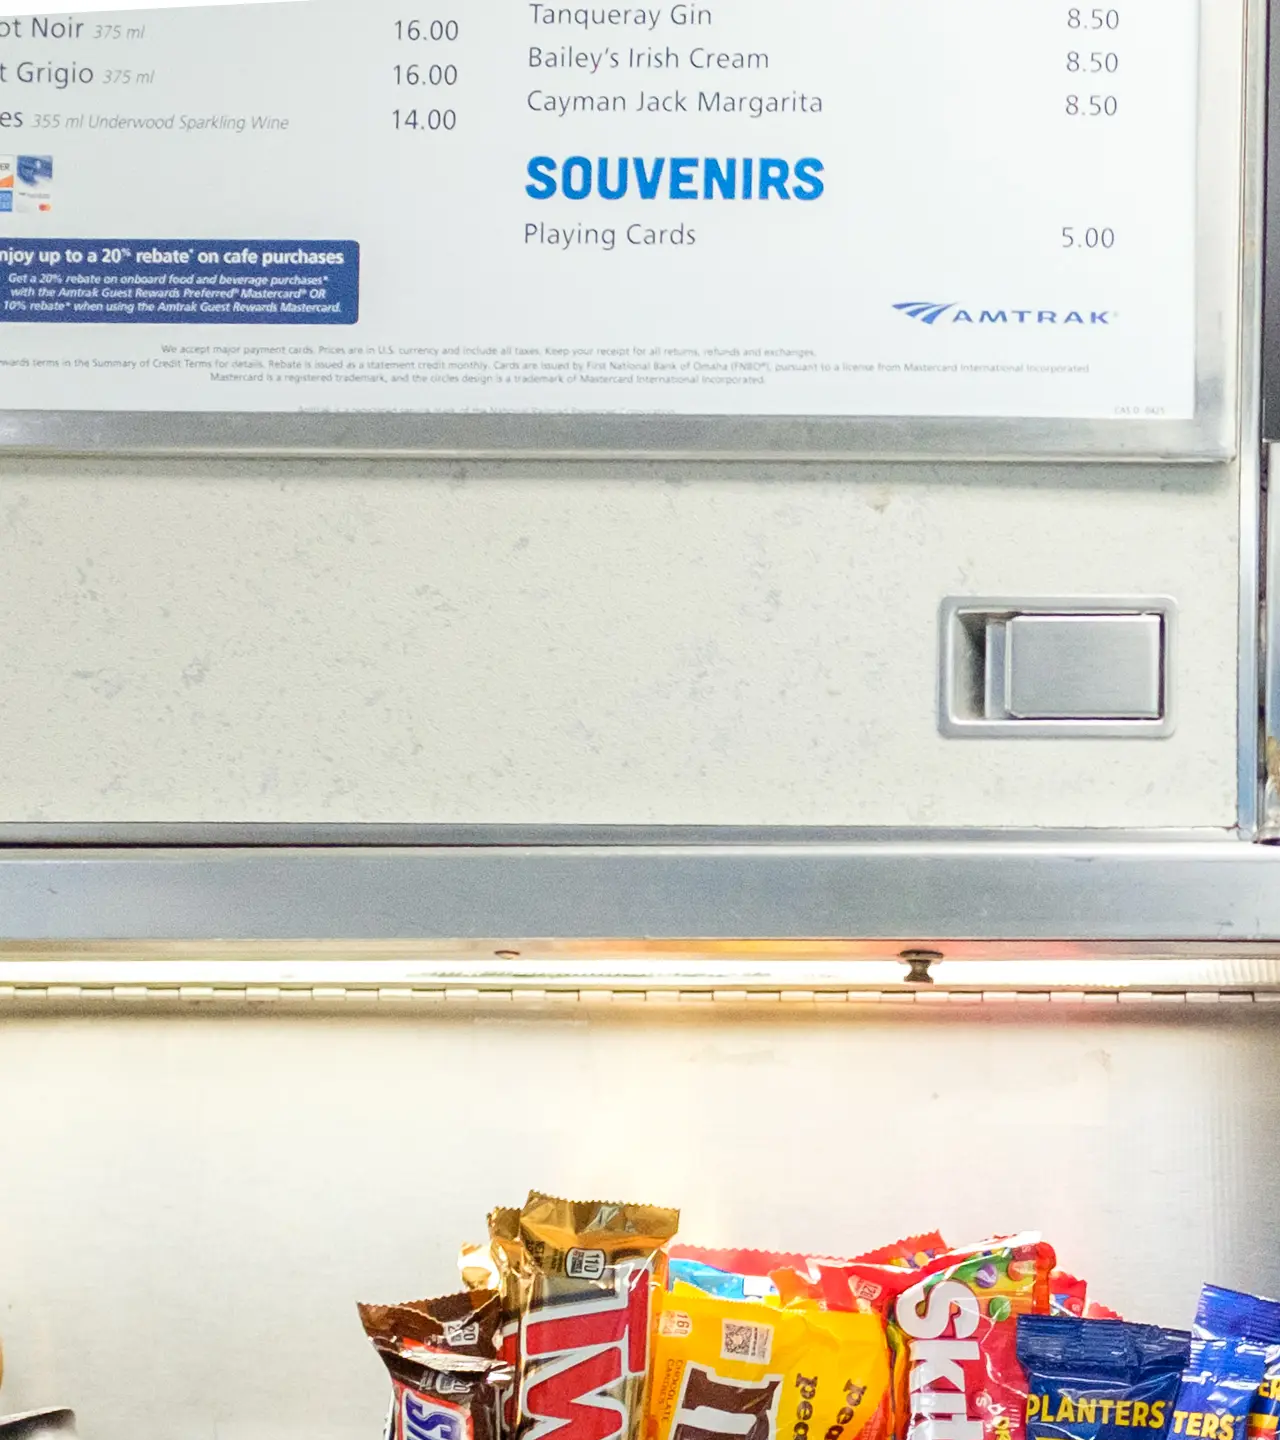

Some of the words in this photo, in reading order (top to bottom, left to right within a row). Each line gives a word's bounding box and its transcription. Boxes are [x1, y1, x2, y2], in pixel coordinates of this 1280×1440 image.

[32, 18, 82, 39] Noir
[93, 25, 121, 39] 375
[126, 24, 145, 39] ml
[394, 20, 459, 41] 16.00
[530, 4, 658, 30] Tanqueray
[669, 4, 712, 26] Gin
[1067, 8, 1120, 30] 8.50
[529, 47, 620, 74] Bailey's
[628, 47, 679, 70] Irish
[688, 48, 770, 70] Cream
[1066, 52, 1119, 74] 8.50
[17, 62, 94, 89] Grigio
[103, 70, 131, 84] 375
[136, 70, 155, 84] ml
[392, 64, 458, 86] 16.00
[527, 90, 626, 119] Cayman
[636, 90, 687, 113] Jack
[697, 90, 823, 119] Margarita
[1065, 96, 1119, 118] 8.50
[30, 114, 60, 128] 355
[66, 114, 83, 128] ml
[88, 115, 174, 130] Underwood
[179, 115, 245, 133] Sparkling
[251, 116, 289, 130] Wine
[392, 109, 456, 131] 14.00
[525, 156, 825, 201] SOUVENIRS
[524, 223, 616, 250] Playing
[626, 223, 696, 246] Cards
[1061, 227, 1115, 249] 5.00
[39, 251, 60, 266] up
[65, 250, 83, 263] to
[102, 248, 132, 263] 20%
[198, 253, 219, 264] on
[223, 249, 257, 264] cafe
[262, 250, 344, 266] purchases
[65, 273, 100, 284] rebate
[120, 274, 166, 284] onboard
[169, 274, 194, 284] food
[219, 274, 268, 286] beverage
[952, 310, 1110, 324] AMTRAK
[1026, 1394, 1166, 1429] PLANTERS
